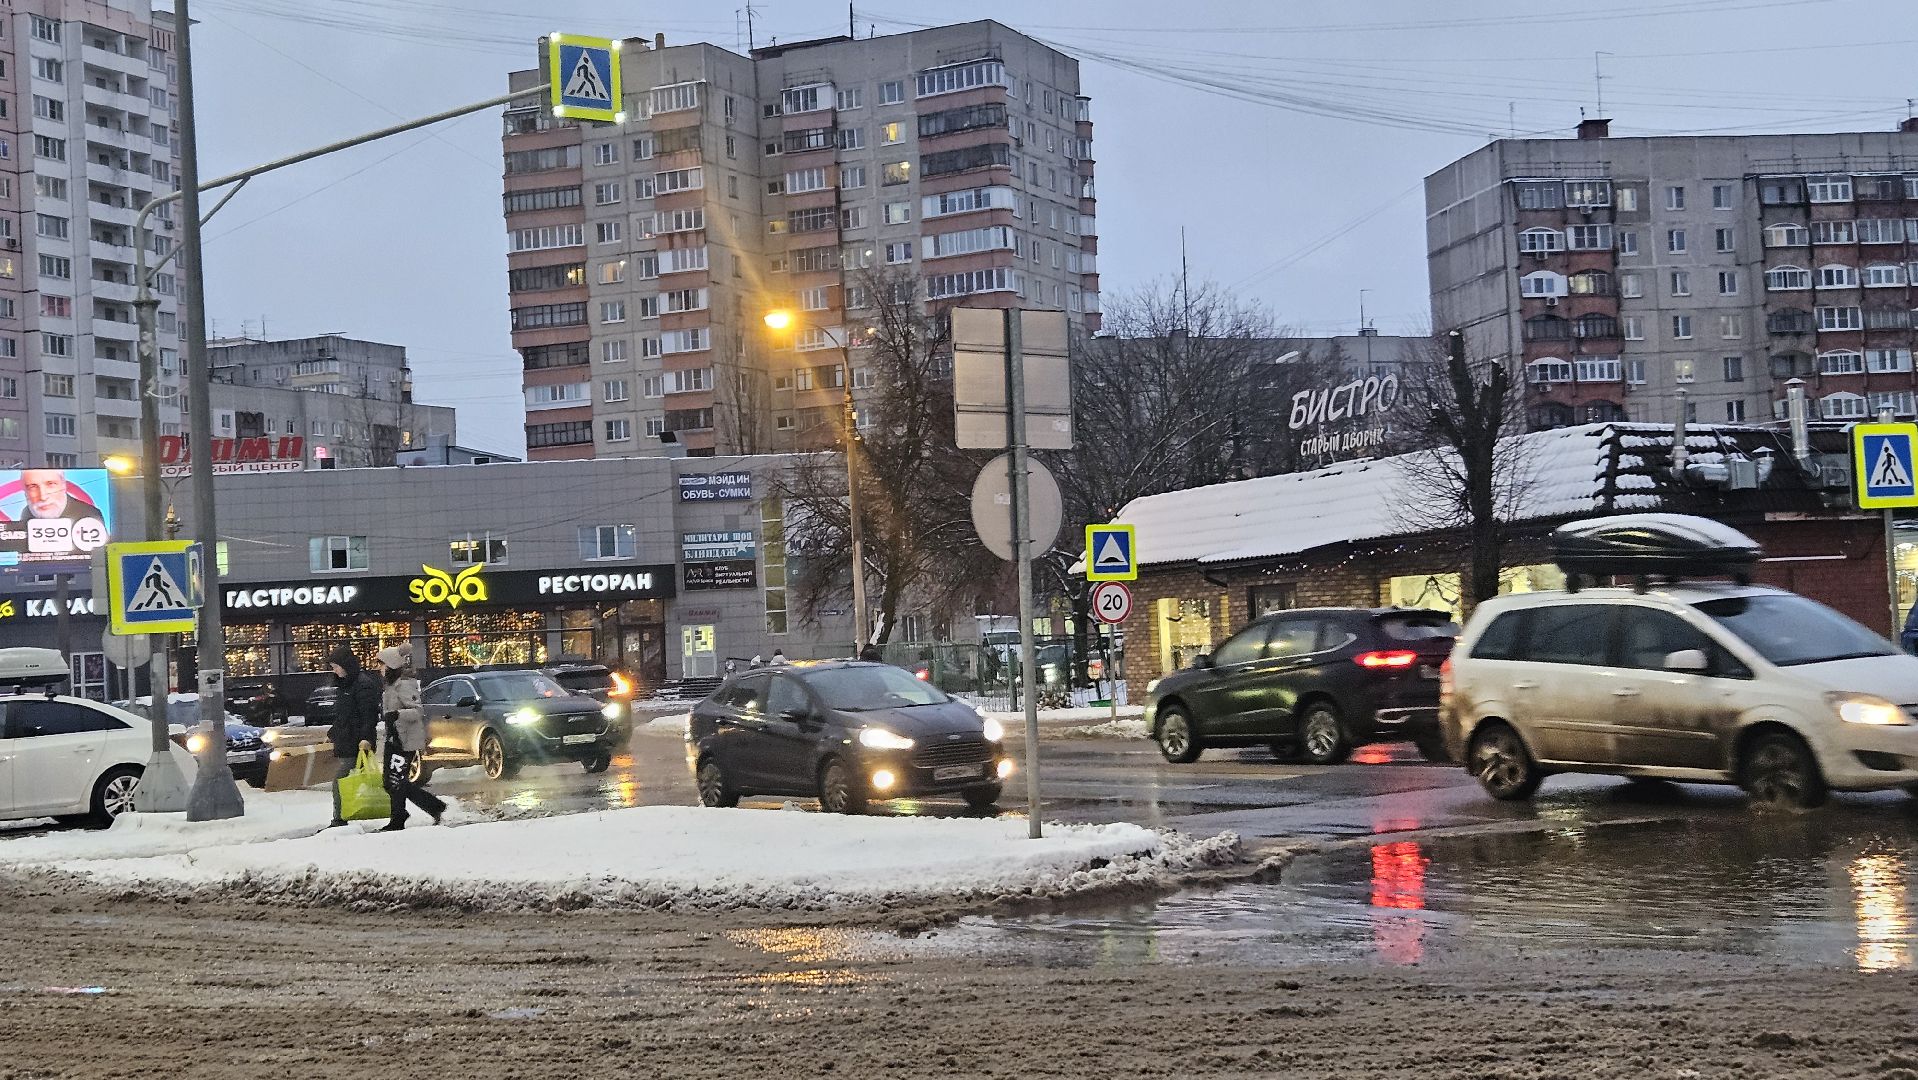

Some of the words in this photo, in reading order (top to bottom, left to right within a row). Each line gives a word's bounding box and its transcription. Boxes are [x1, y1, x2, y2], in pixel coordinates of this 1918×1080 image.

[1288, 373, 1399, 429] БИСТРО
[1300, 432, 1340, 456] СТАРЫЙ
[1342, 428, 1385, 451] ДВОРИК
[249, 463, 300, 472] ЦЕНТР
[32, 527, 69, 539] 390
[684, 533, 729, 542] МИЛИТАРИ
[732, 532, 752, 541] ШОП
[684, 548, 737, 559] БЛИНДАЖ
[538, 573, 652, 594] РЕСТОРАН
[226, 585, 358, 608] ГАСТРОБАР
[1102, 594, 1123, 610] 20
[390, 753, 406, 773] R
